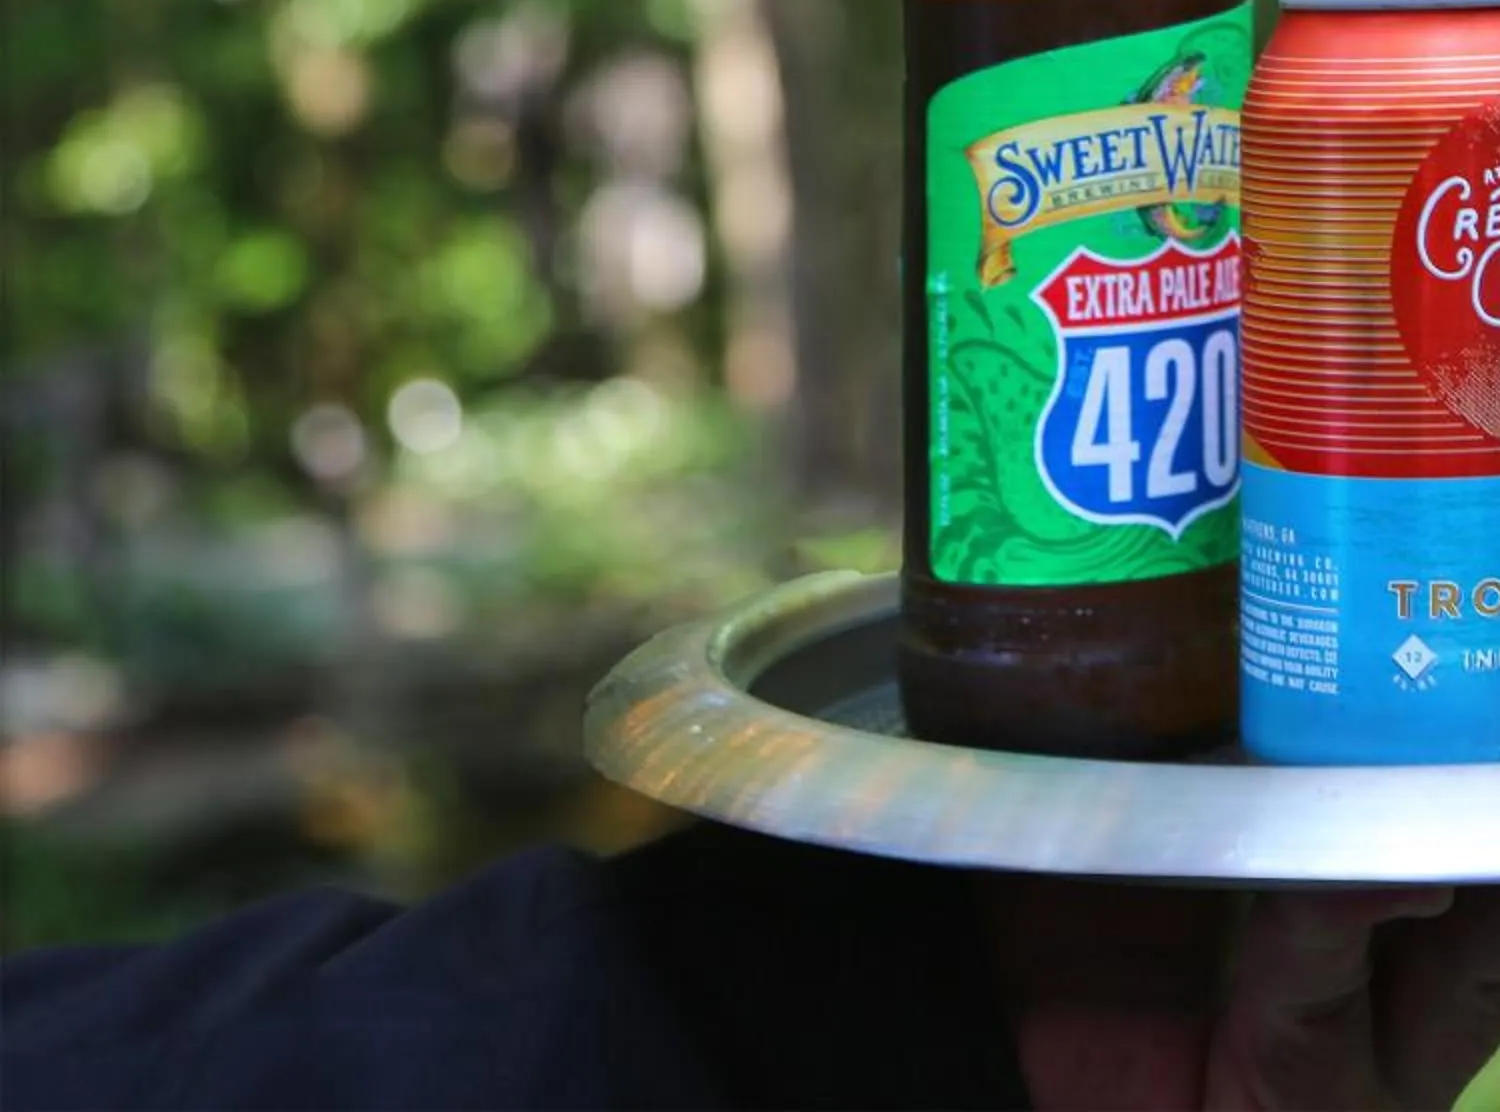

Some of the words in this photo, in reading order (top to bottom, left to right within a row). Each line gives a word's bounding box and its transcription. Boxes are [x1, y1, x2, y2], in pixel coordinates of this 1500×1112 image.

[1066, 272, 1155, 321] EXTRA
[1159, 263, 1212, 312] PALE
[1071, 329, 1238, 504] 420
[1404, 651, 1423, 664] 12
